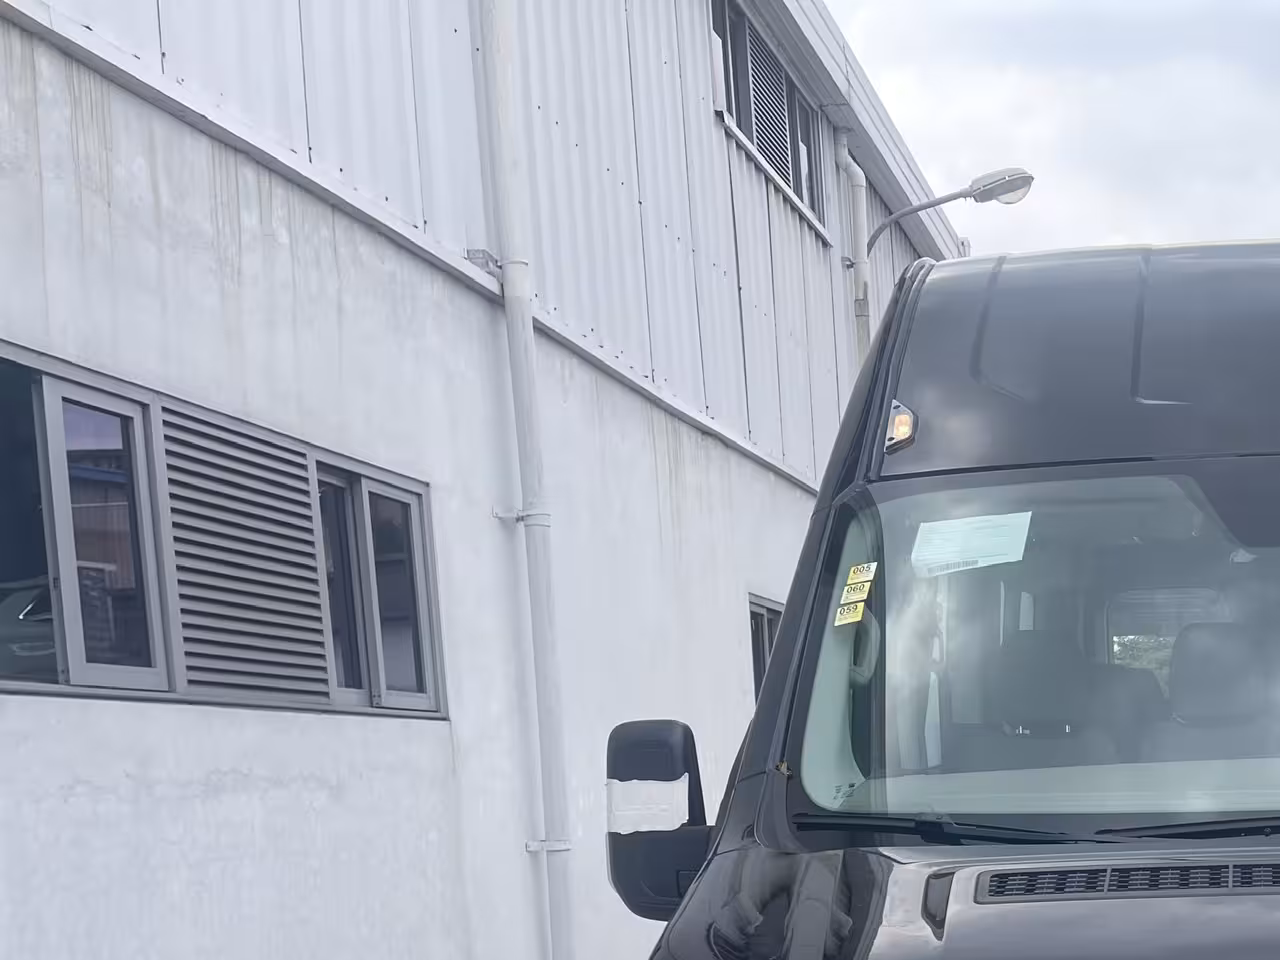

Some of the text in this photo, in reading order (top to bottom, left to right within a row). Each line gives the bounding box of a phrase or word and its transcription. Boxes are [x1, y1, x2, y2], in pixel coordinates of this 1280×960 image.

[853, 565, 871, 575] 005
[847, 584, 865, 593] 060
[840, 604, 858, 615] 059
